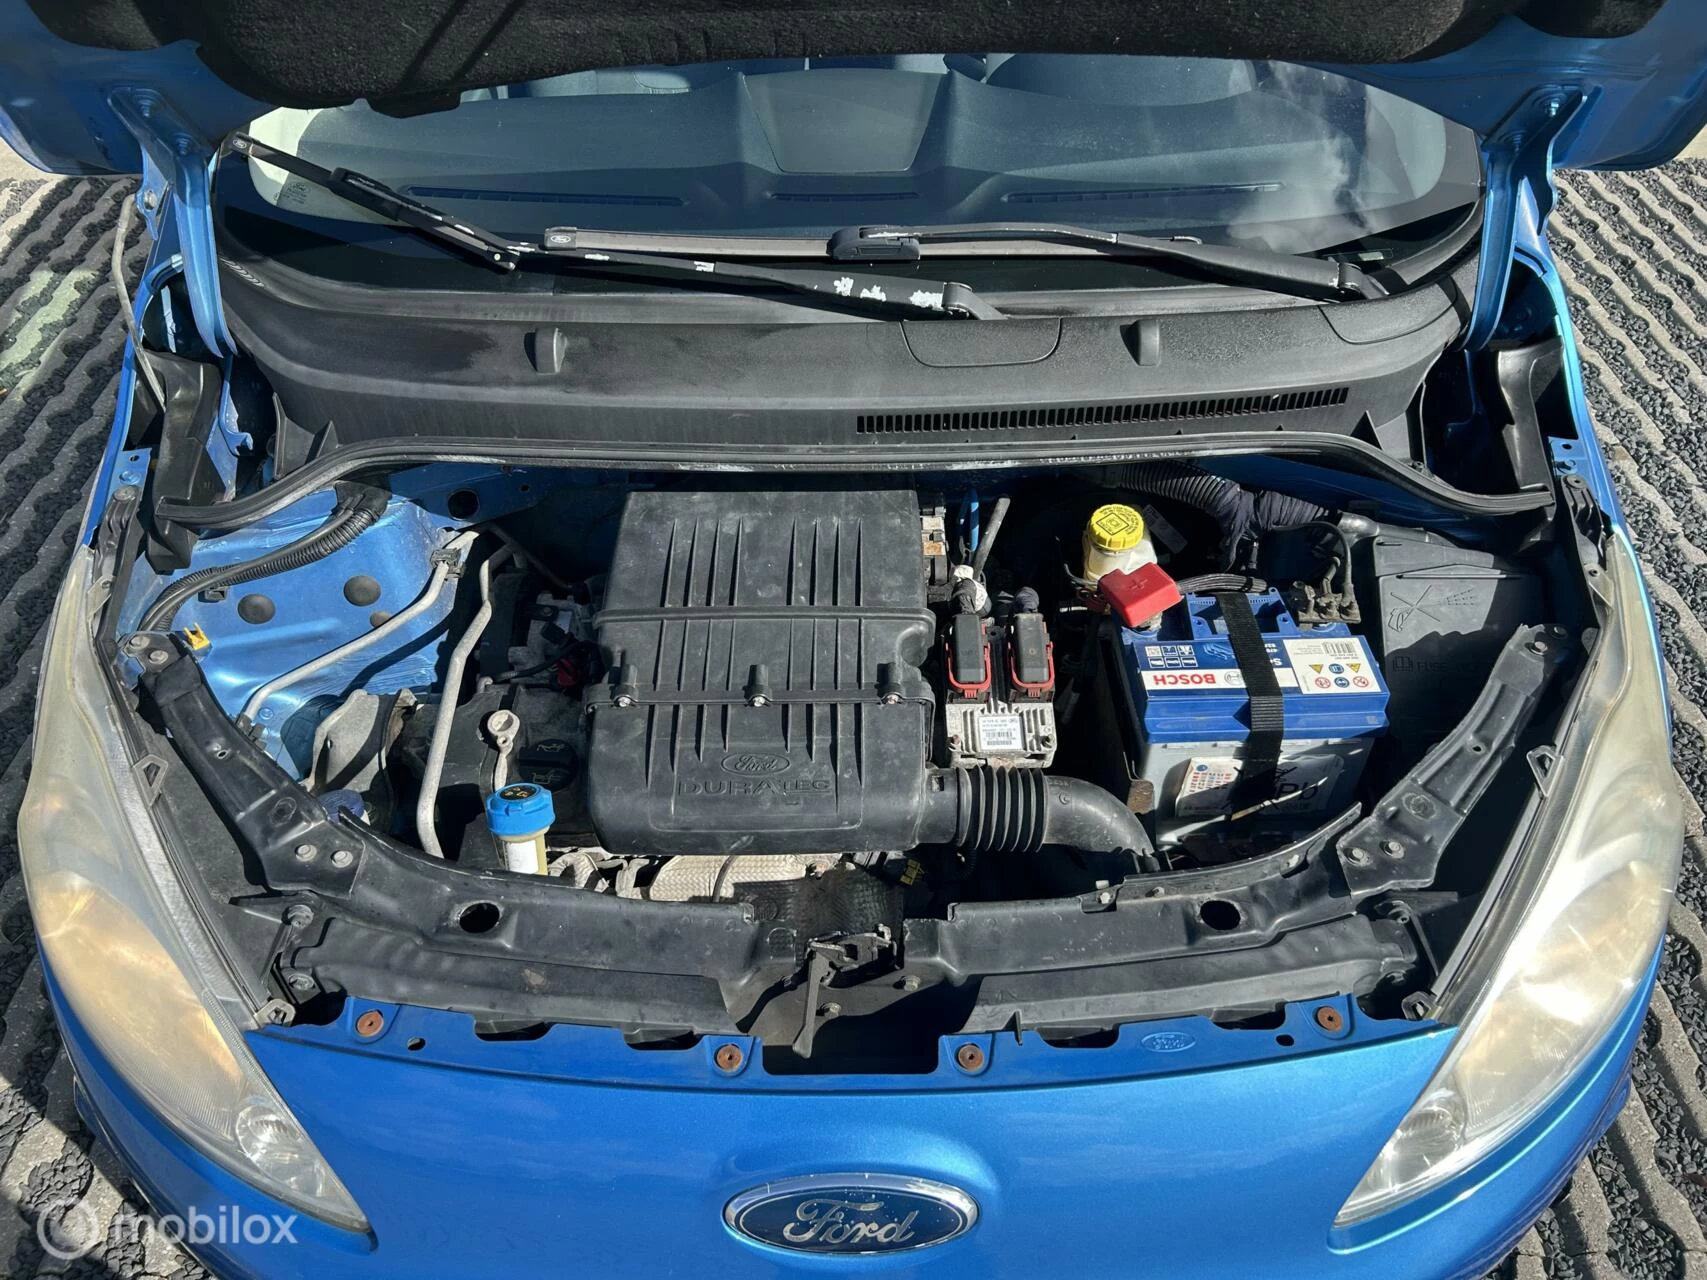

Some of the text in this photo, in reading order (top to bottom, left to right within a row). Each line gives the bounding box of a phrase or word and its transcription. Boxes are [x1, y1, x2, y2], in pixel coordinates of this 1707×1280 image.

[1153, 673, 1216, 685] BOSCH
[734, 753, 778, 772] Ford
[1152, 1034, 1185, 1050] Ford
[782, 1198, 920, 1244] Ford
